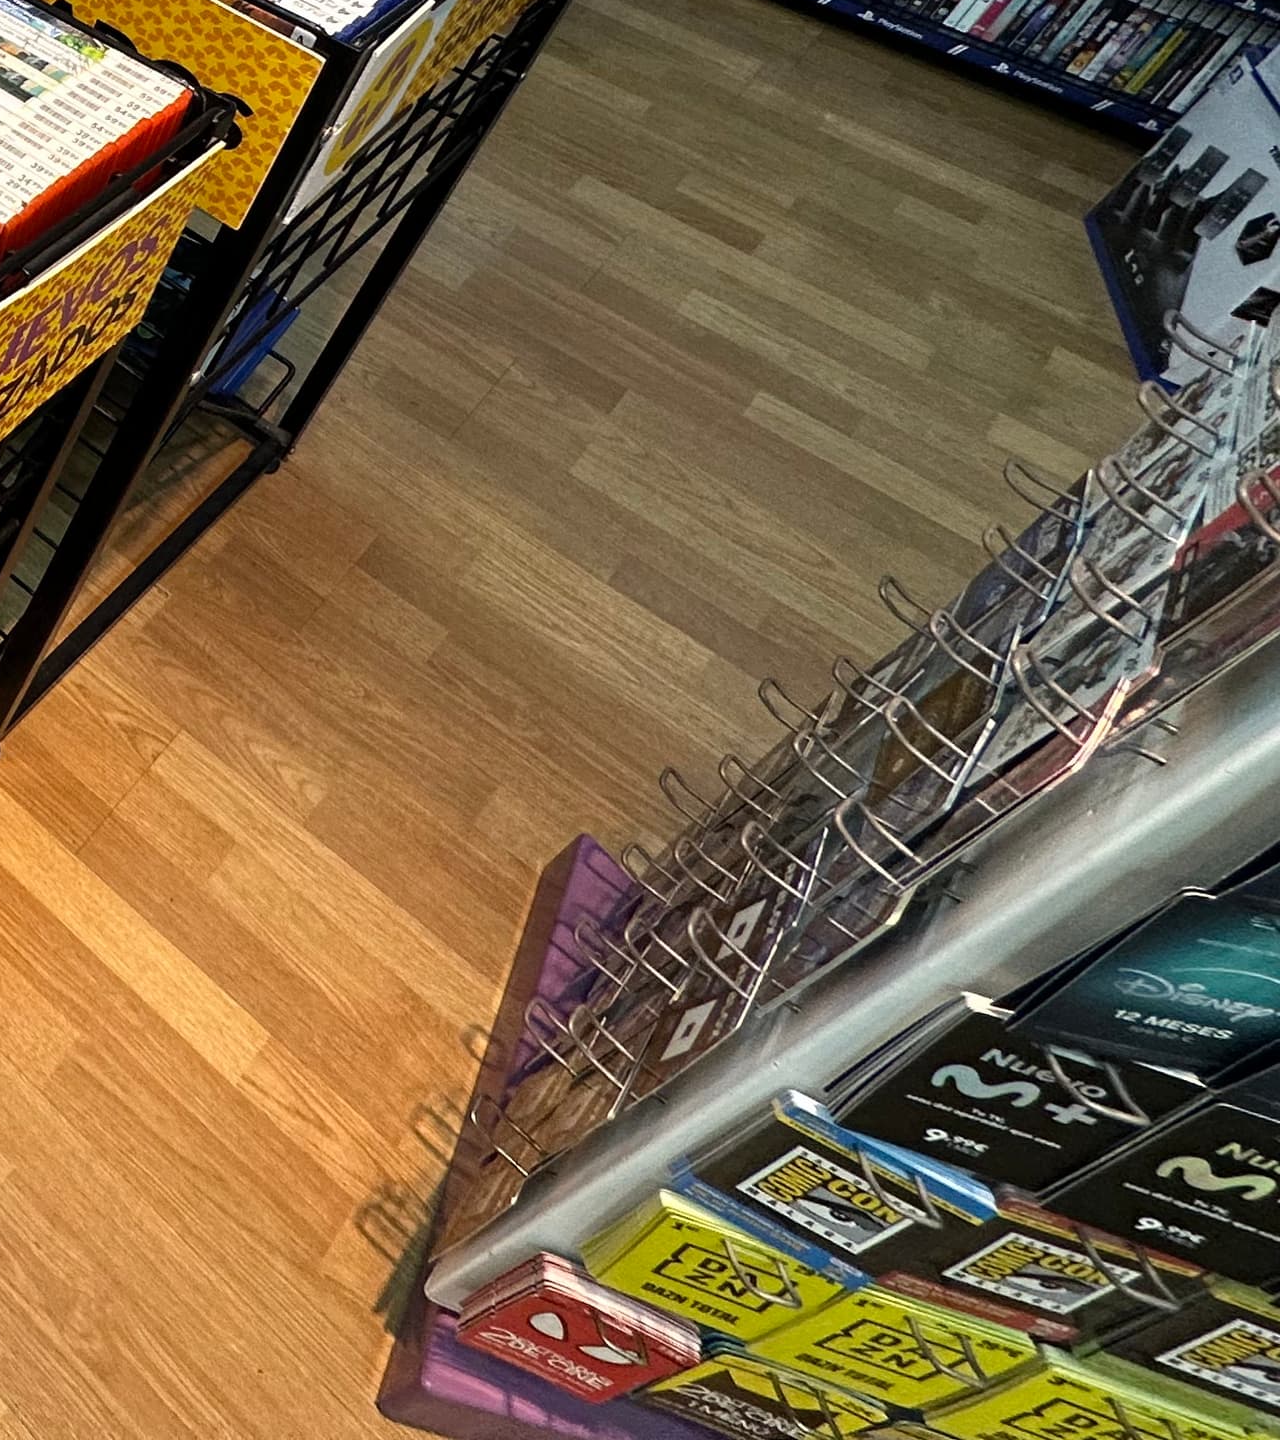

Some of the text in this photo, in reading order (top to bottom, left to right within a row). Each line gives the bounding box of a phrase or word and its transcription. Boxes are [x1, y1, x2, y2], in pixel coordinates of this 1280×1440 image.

[1142, 1014, 1233, 1043] MESES
[760, 1157, 900, 1225] COMIC CON
[971, 1246, 1030, 1285] COMIC
[690, 1300, 739, 1327] TOTAL
